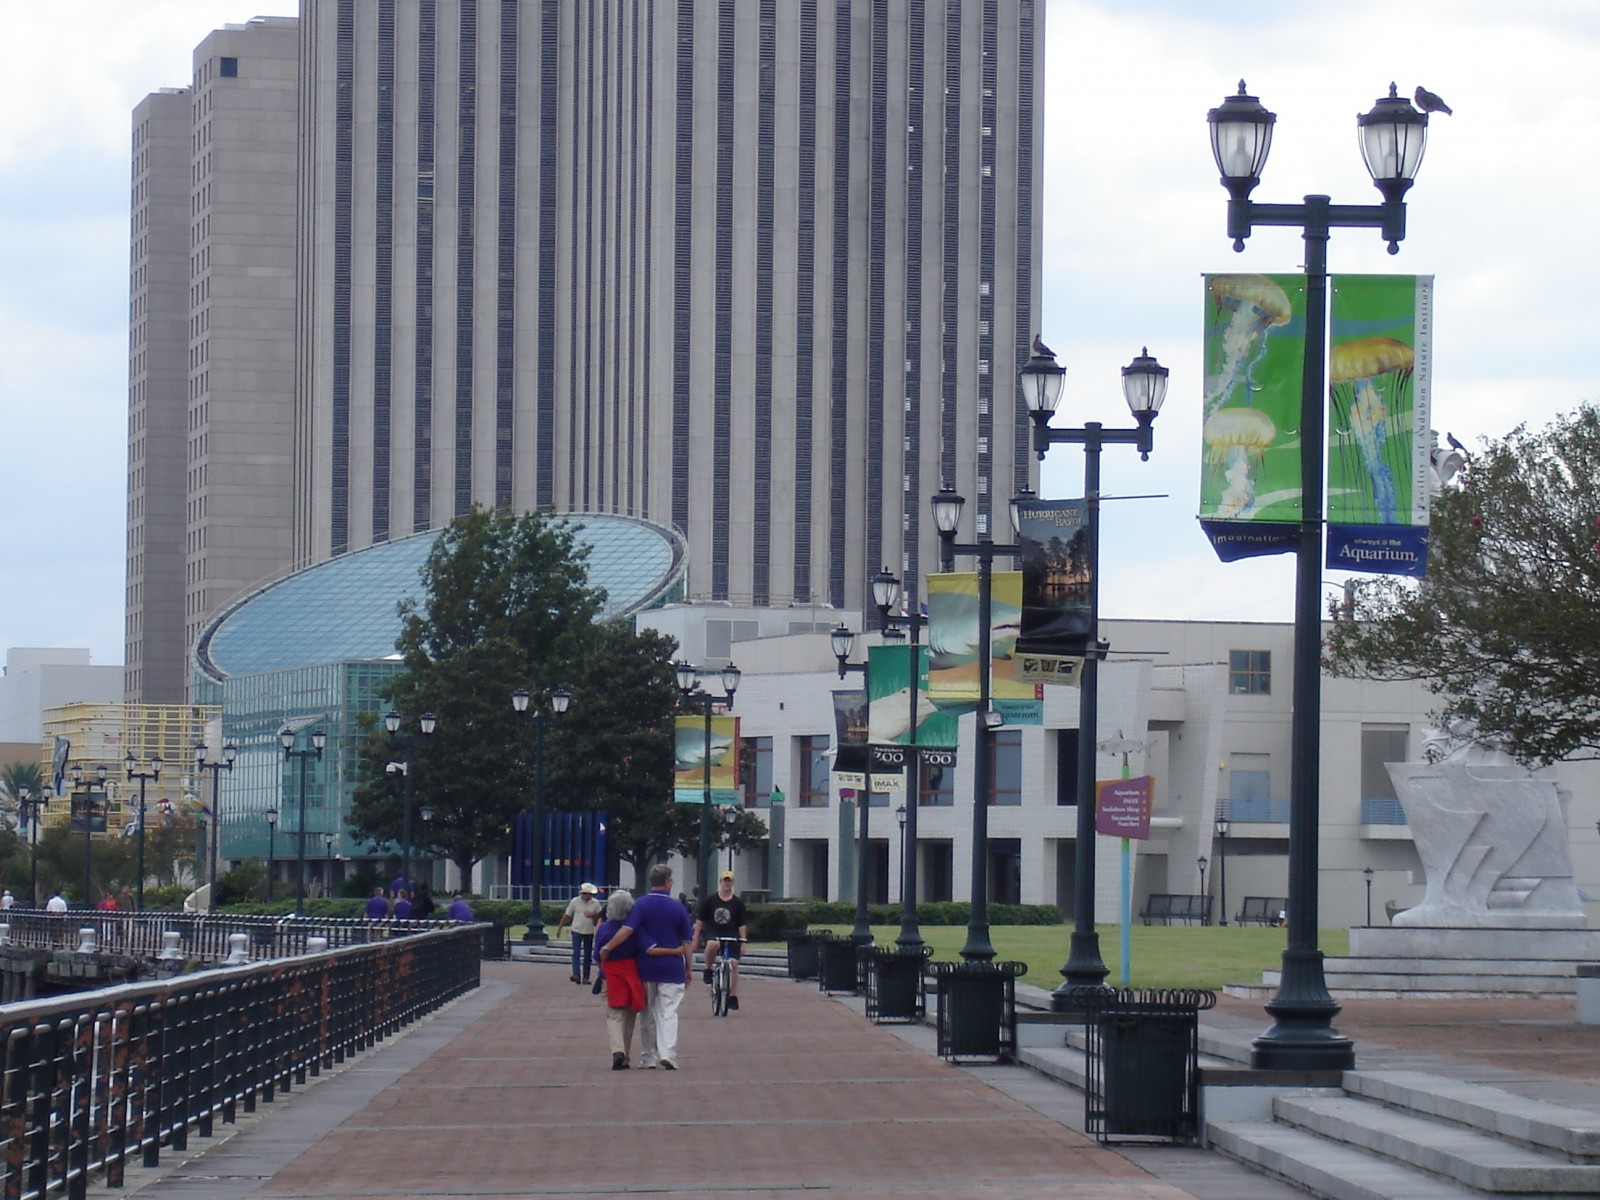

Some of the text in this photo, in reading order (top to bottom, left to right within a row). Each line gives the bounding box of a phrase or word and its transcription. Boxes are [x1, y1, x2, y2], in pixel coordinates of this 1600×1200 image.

[1419, 282, 1429, 336] Institute
[1418, 341, 1428, 382] Nature
[1417, 387, 1427, 439] Audubon
[1417, 445, 1425, 457] of
[1417, 463, 1427, 511] Facility
[874, 752, 904, 763] ZOO
